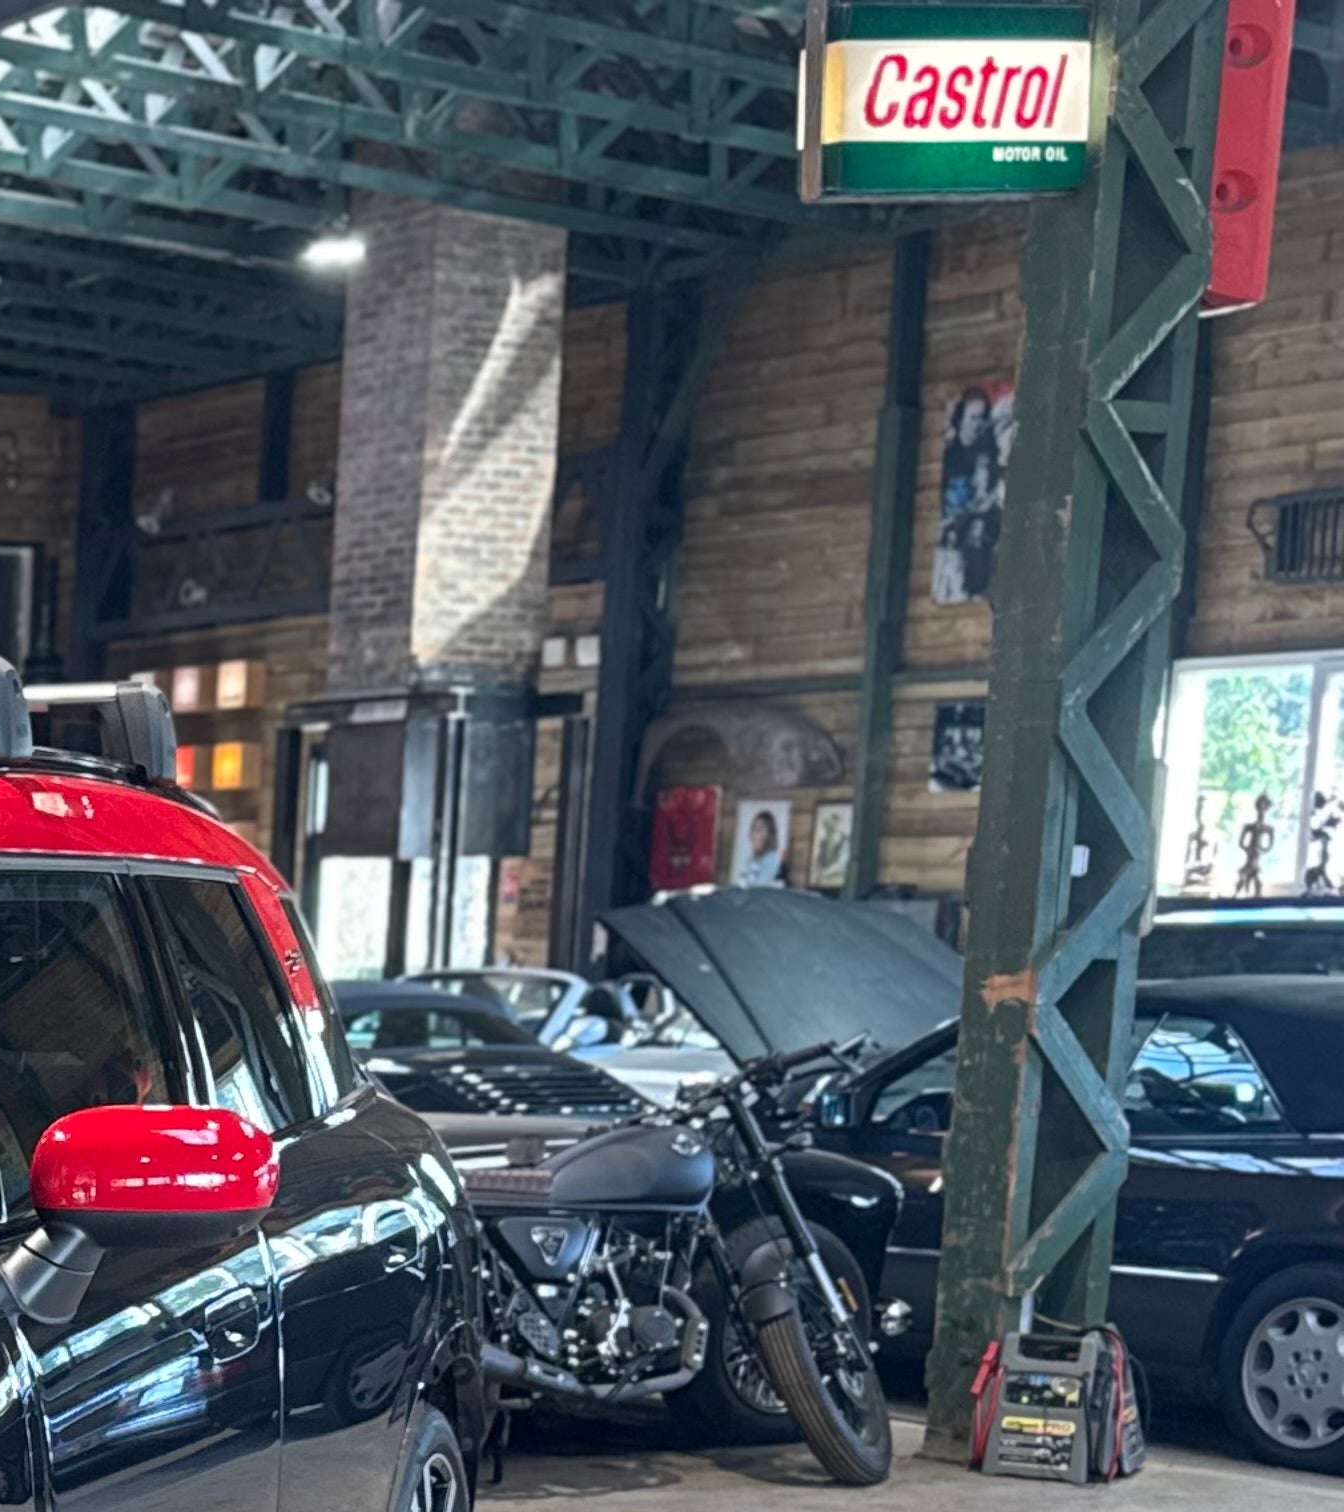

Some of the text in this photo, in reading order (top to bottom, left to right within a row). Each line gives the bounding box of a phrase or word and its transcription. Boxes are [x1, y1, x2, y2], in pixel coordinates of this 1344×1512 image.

[864, 54, 1069, 129] Castrol
[992, 146, 1069, 162] MOTOR OIL
